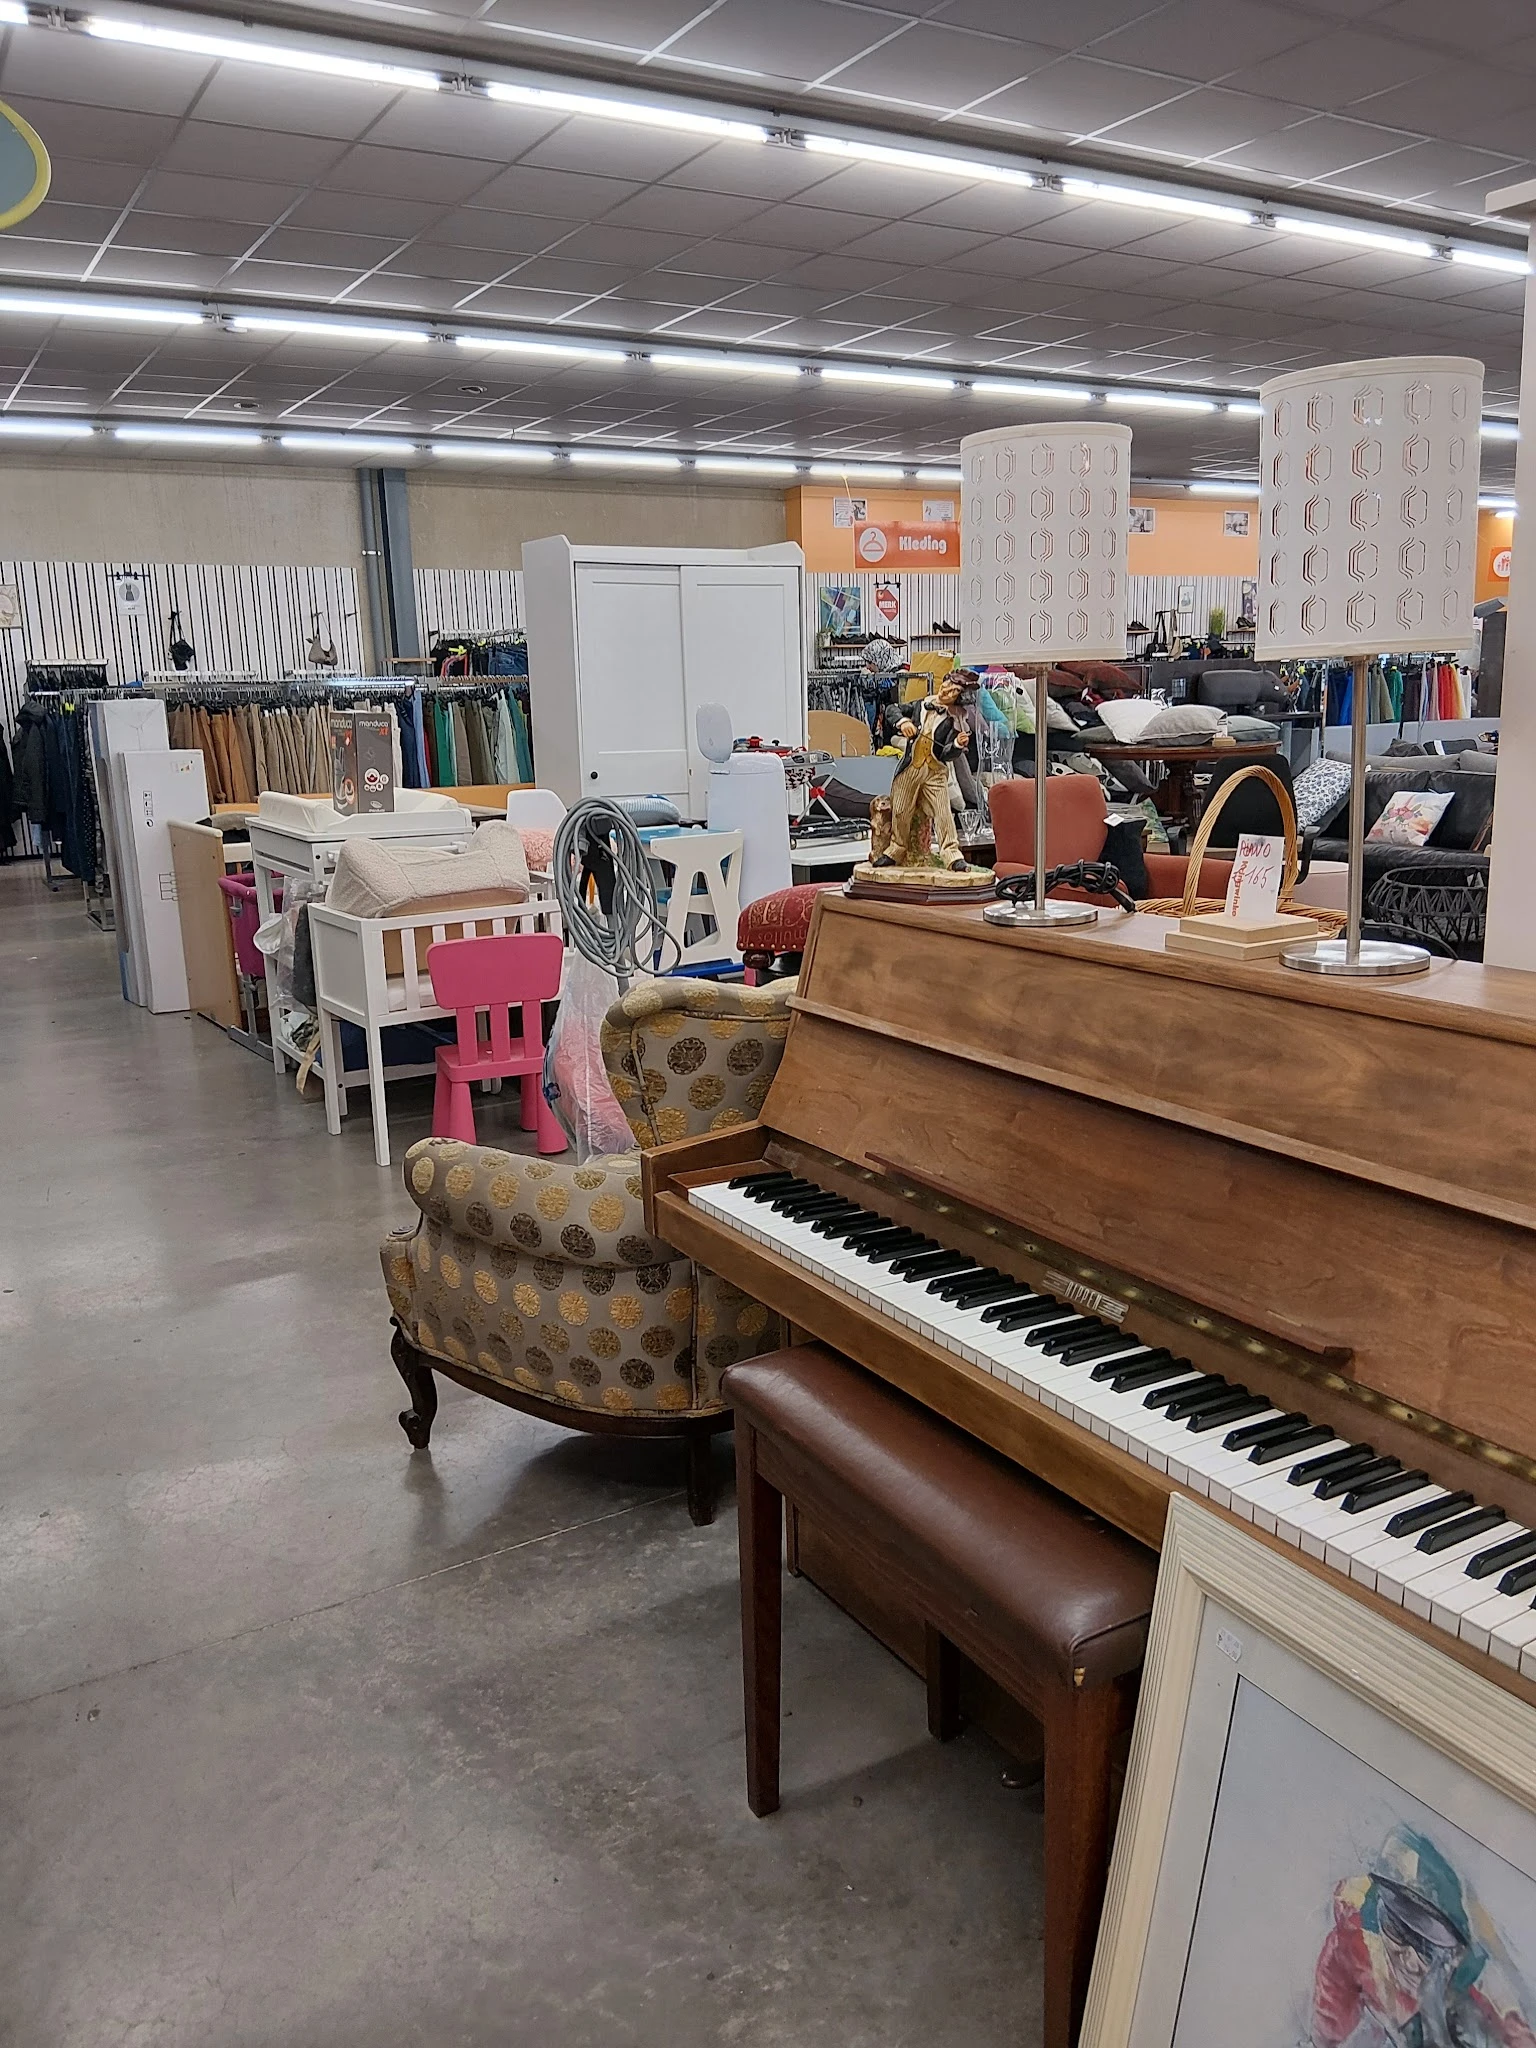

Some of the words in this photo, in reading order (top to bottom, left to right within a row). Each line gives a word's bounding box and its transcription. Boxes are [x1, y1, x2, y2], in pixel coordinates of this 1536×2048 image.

[899, 535, 947, 555] Kleding
[878, 600, 897, 609] MERK
[359, 720, 389, 728] manduca
[1245, 866, 1275, 888] 165
